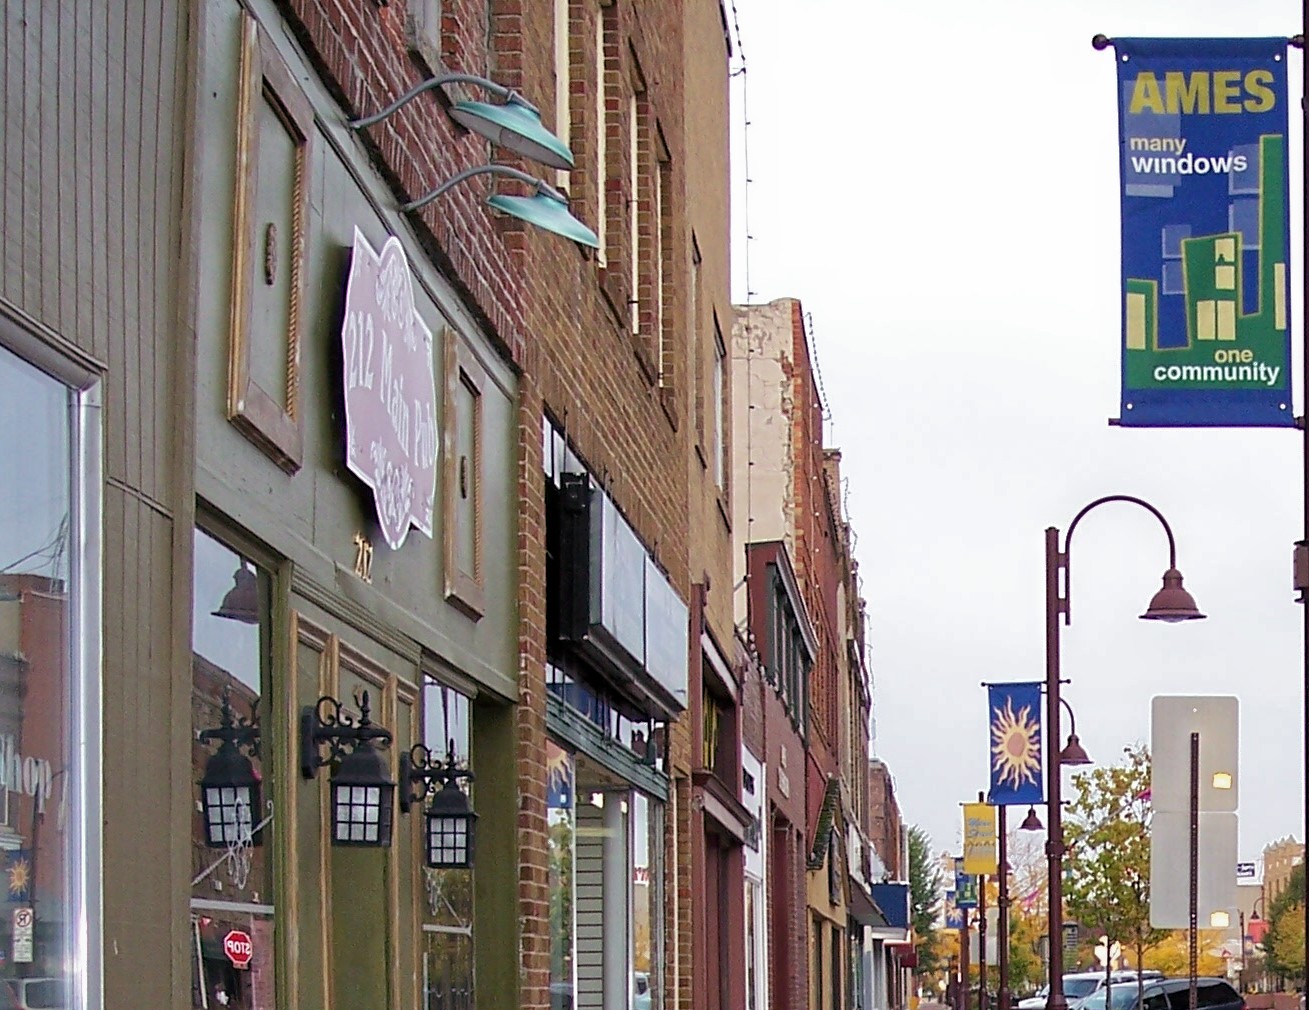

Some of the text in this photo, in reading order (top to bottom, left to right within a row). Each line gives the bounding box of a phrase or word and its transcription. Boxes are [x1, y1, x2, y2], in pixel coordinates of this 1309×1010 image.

[1129, 69, 1276, 115] AMES
[1130, 137, 1187, 155] many
[1131, 152, 1248, 174] windows
[1214, 348, 1253, 363] one
[1153, 362, 1280, 386] community
[349, 310, 435, 470] 212 Main Pub
[0, 732, 52, 814] hop
